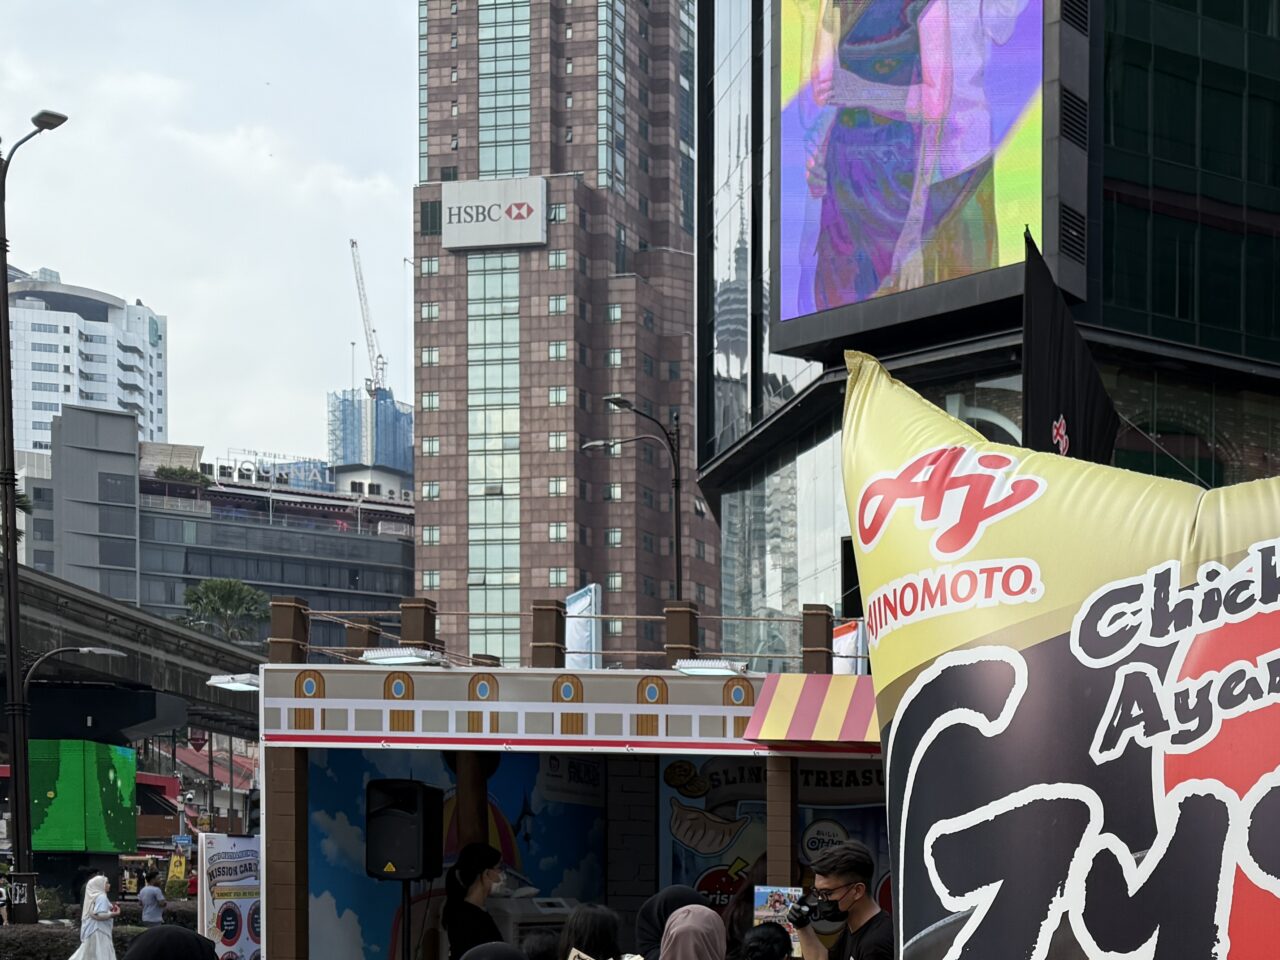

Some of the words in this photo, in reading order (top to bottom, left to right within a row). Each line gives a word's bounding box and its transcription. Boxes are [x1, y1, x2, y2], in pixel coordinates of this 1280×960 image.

[447, 204, 502, 225] HSBC
[227, 458, 337, 485] JOURNAL
[866, 564, 1034, 642] AJINOMOTO
[709, 765, 768, 789] SLIN
[799, 768, 885, 788] TREASU
[208, 866, 238, 881] MISSION
